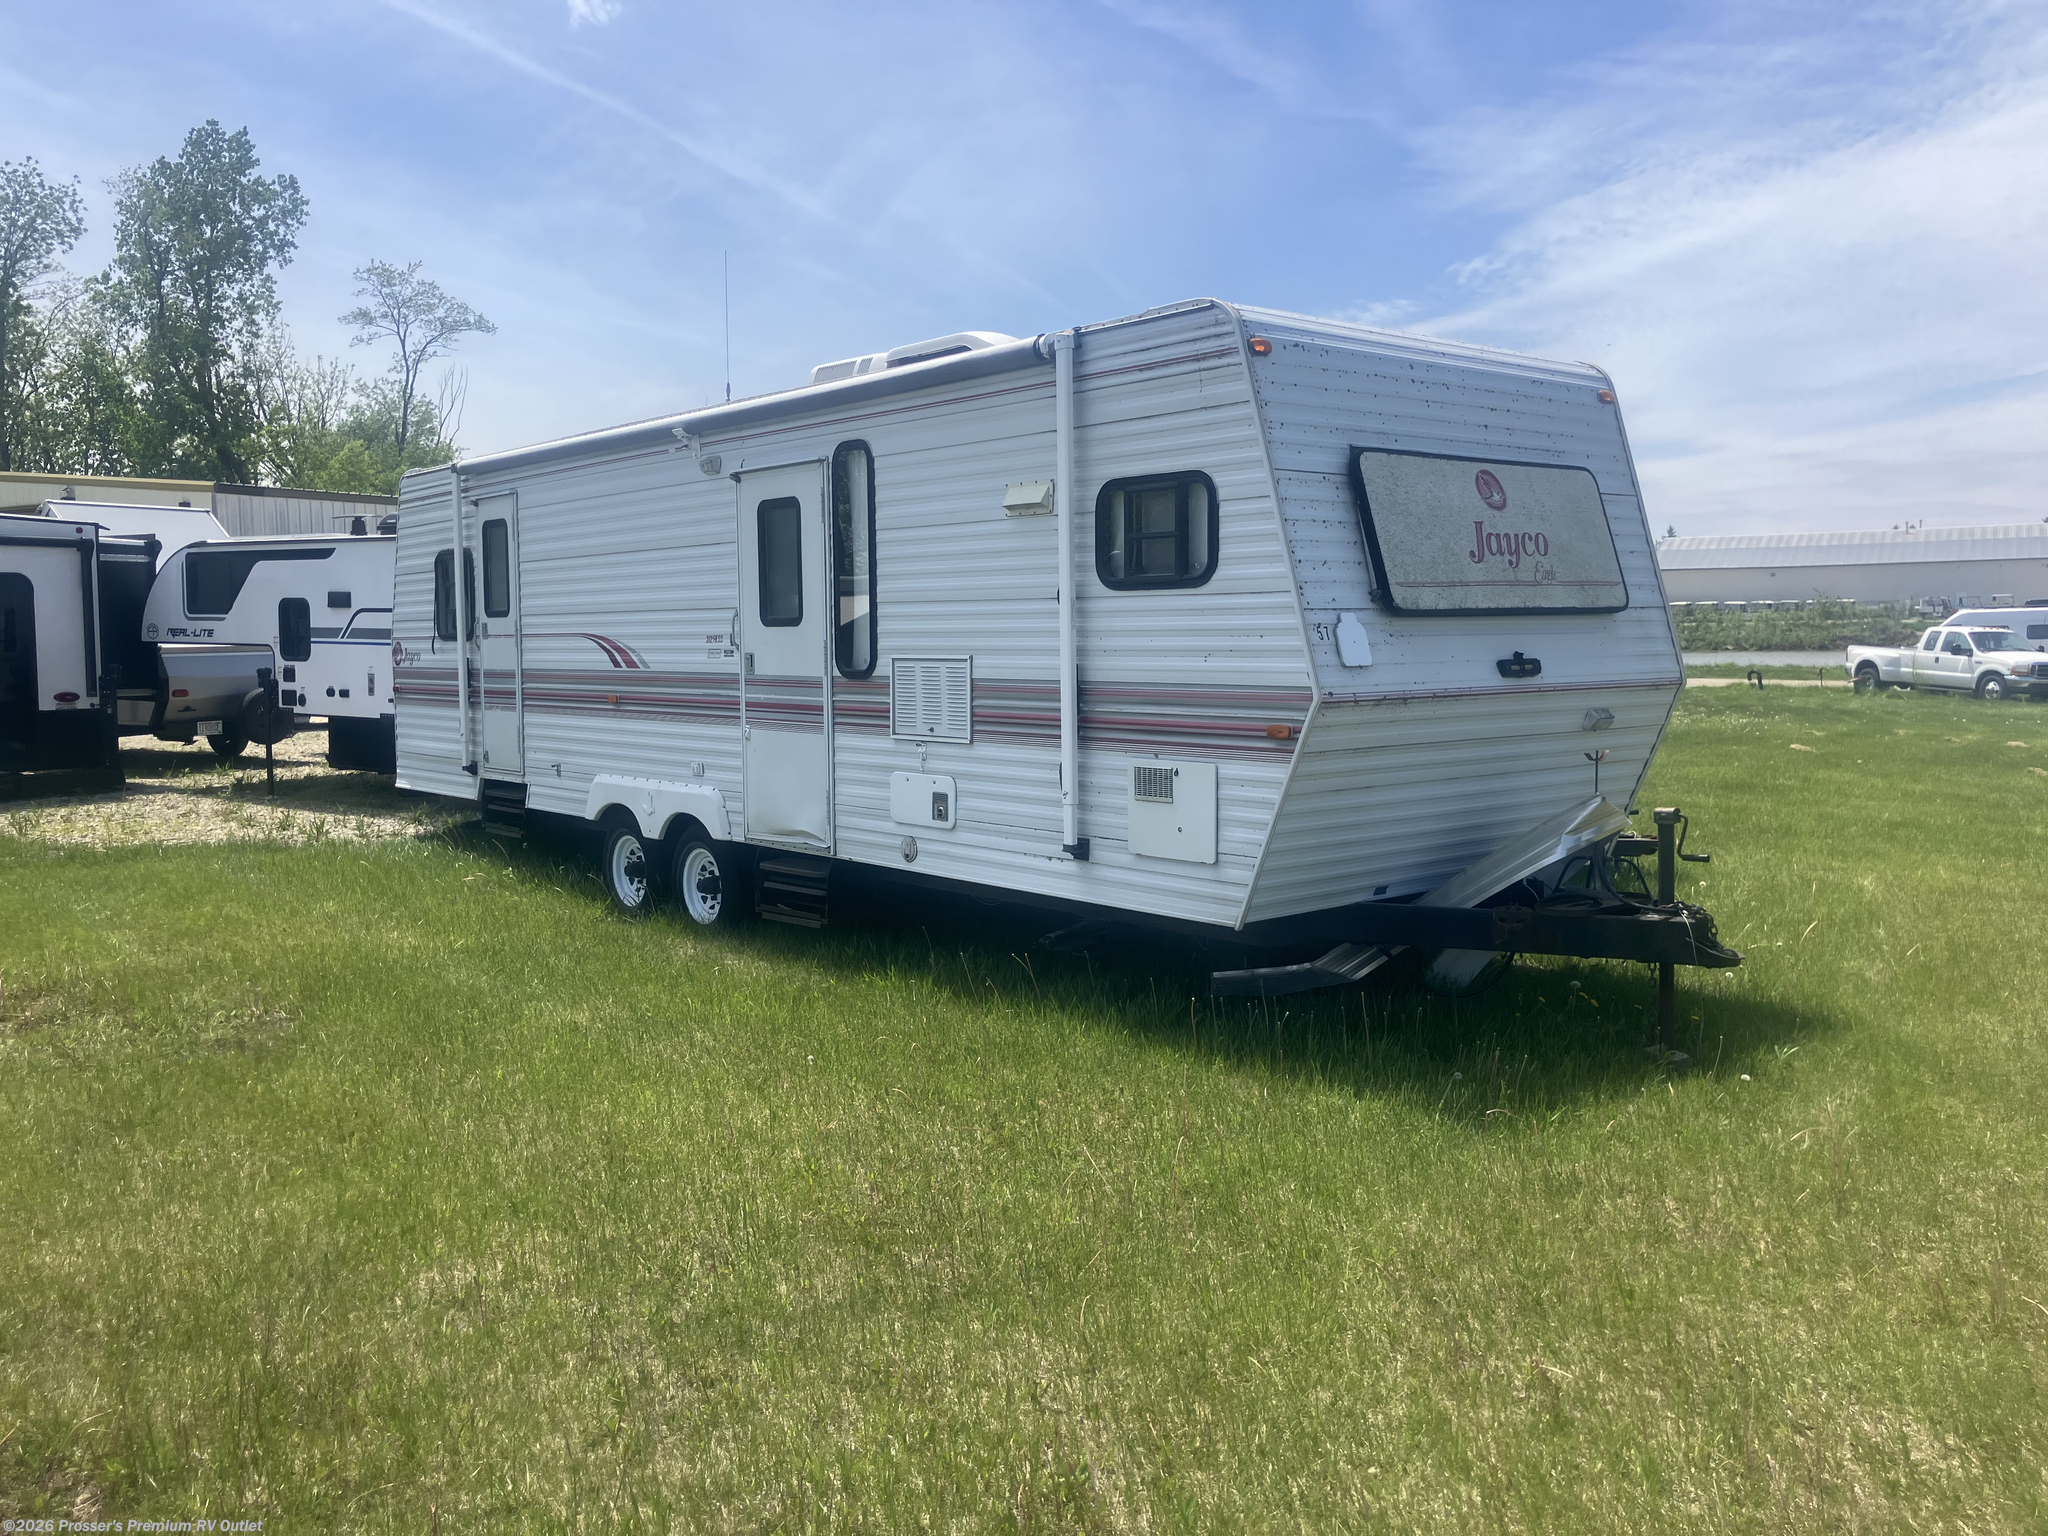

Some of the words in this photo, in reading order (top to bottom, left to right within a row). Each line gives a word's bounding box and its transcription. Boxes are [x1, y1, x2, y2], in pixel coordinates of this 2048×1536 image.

[1469, 521, 1549, 569] Jayco
[1534, 561, 1558, 584] Eagle
[402, 648, 421, 666] Jayco
